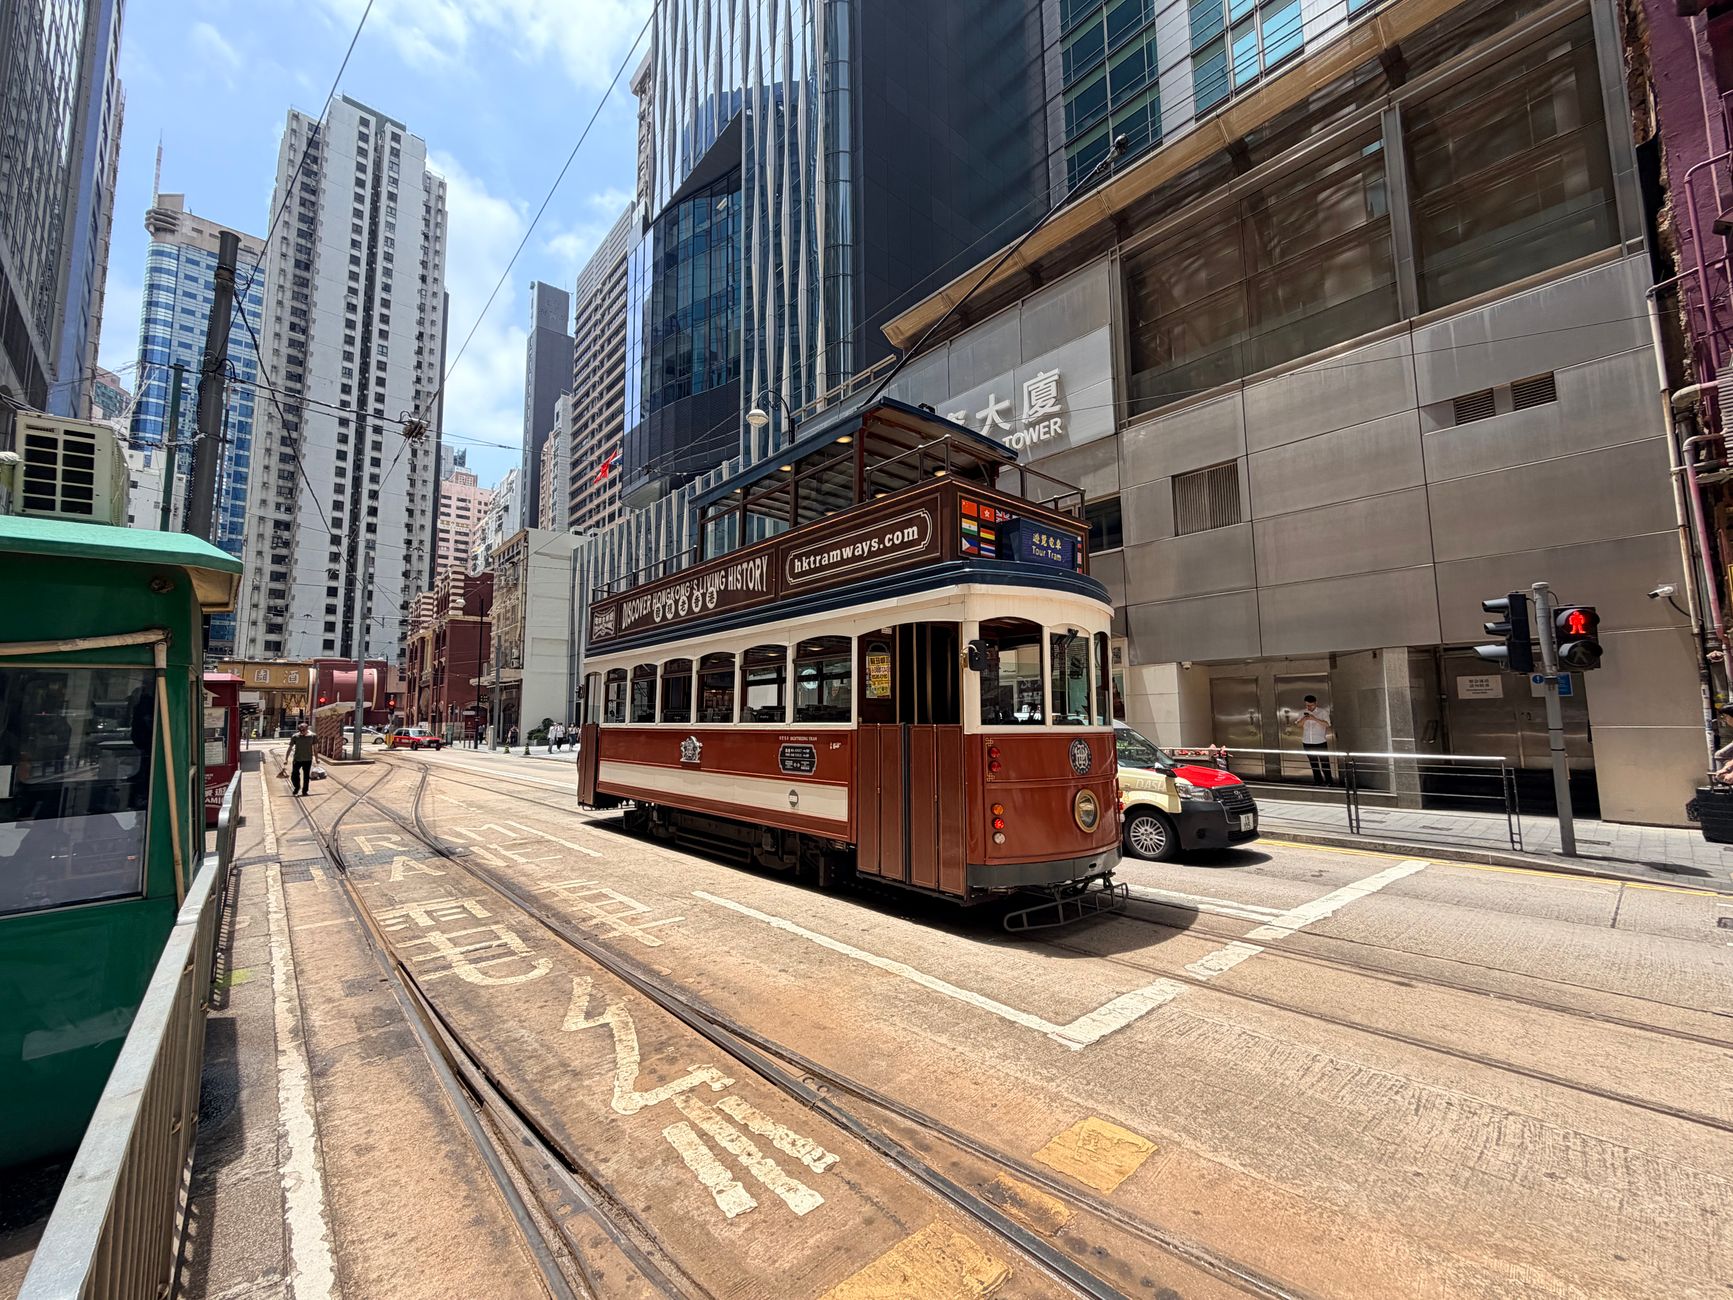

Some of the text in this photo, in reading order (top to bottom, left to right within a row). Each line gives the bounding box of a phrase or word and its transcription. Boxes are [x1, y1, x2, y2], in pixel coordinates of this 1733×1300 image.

[1002, 417, 1063, 450] TOWER
[794, 525, 919, 573] hktramways.com
[1032, 545, 1062, 562] Tour Tram
[621, 594, 651, 630] DISCOVER
[699, 569, 726, 594] LIVING
[728, 555, 768, 592] HISTORY
